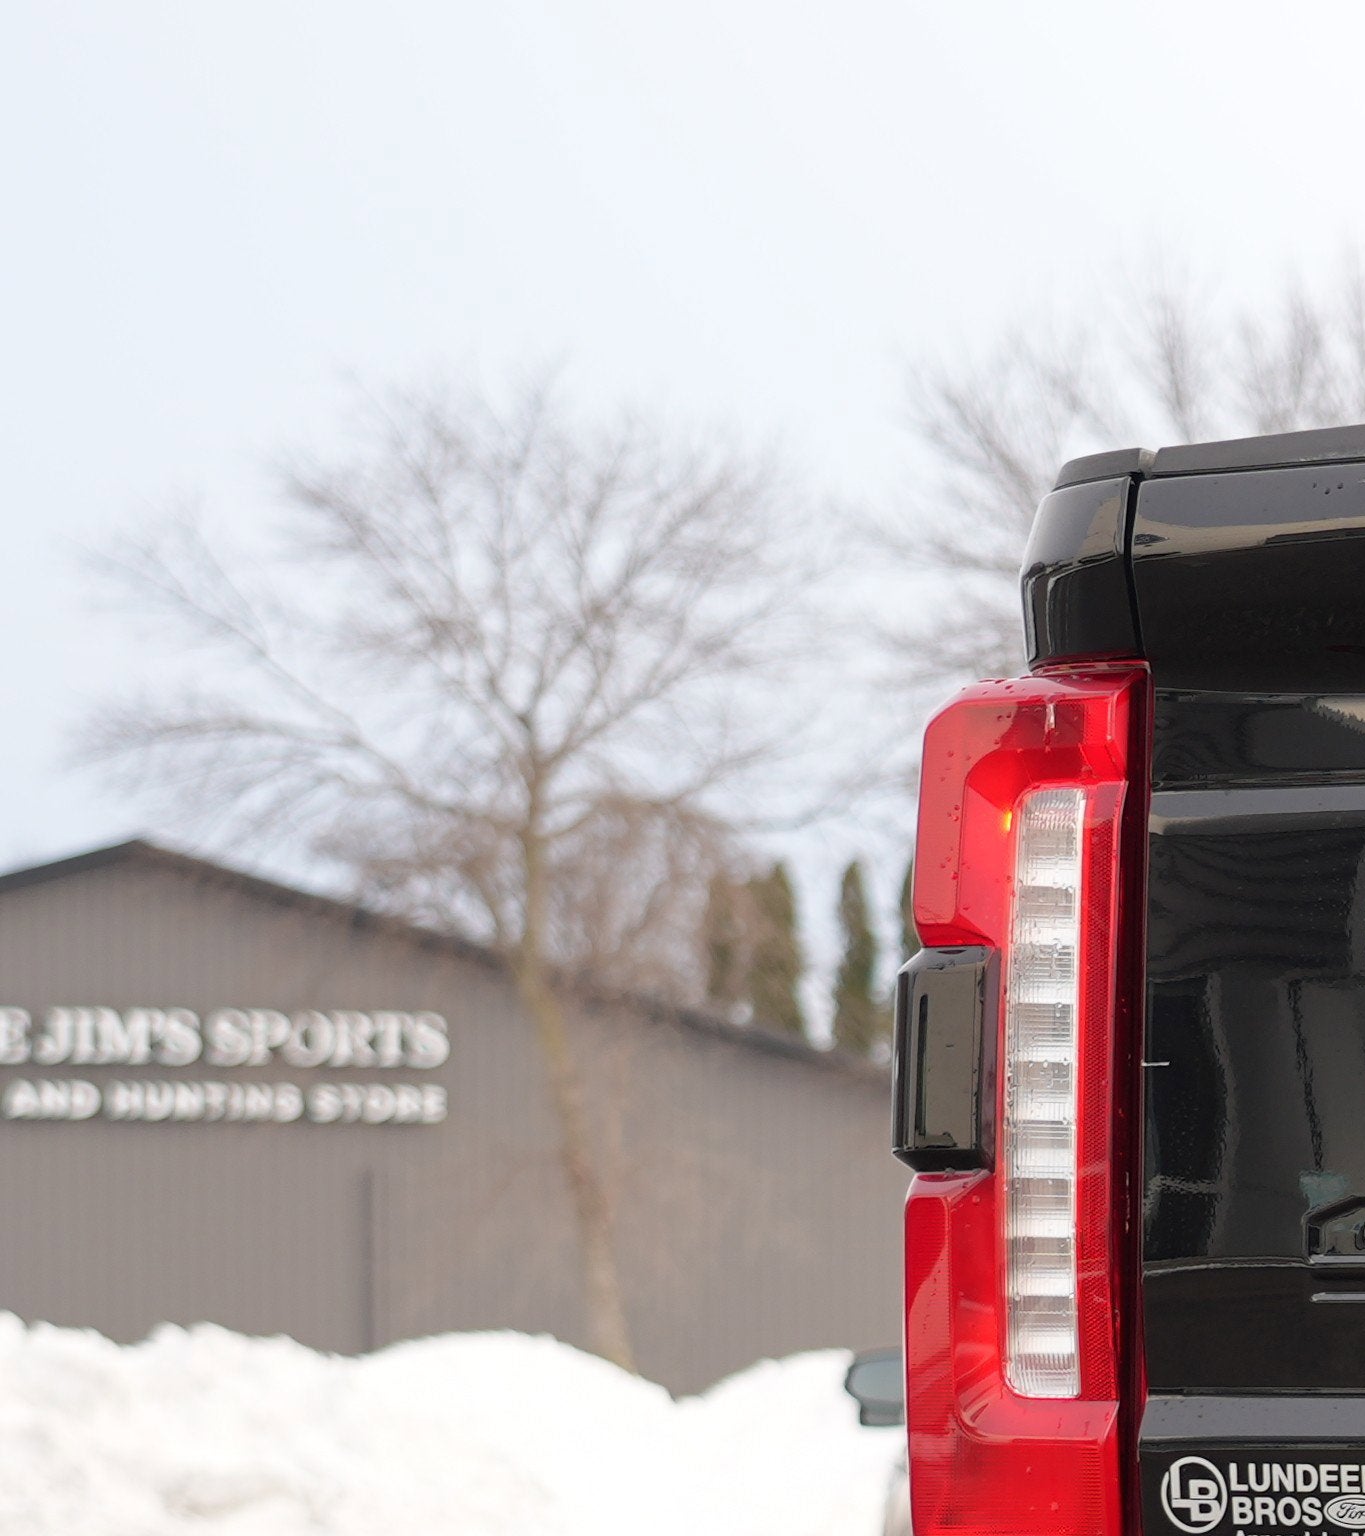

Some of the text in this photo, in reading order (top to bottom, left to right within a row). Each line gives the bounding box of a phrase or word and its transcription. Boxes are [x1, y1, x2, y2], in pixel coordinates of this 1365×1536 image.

[33, 1006, 203, 1067] JIM'S
[203, 1007, 451, 1069] SPORTS
[3, 1078, 448, 1124] AND HUNTING STORE
[1231, 1496, 1324, 1527] BROS
